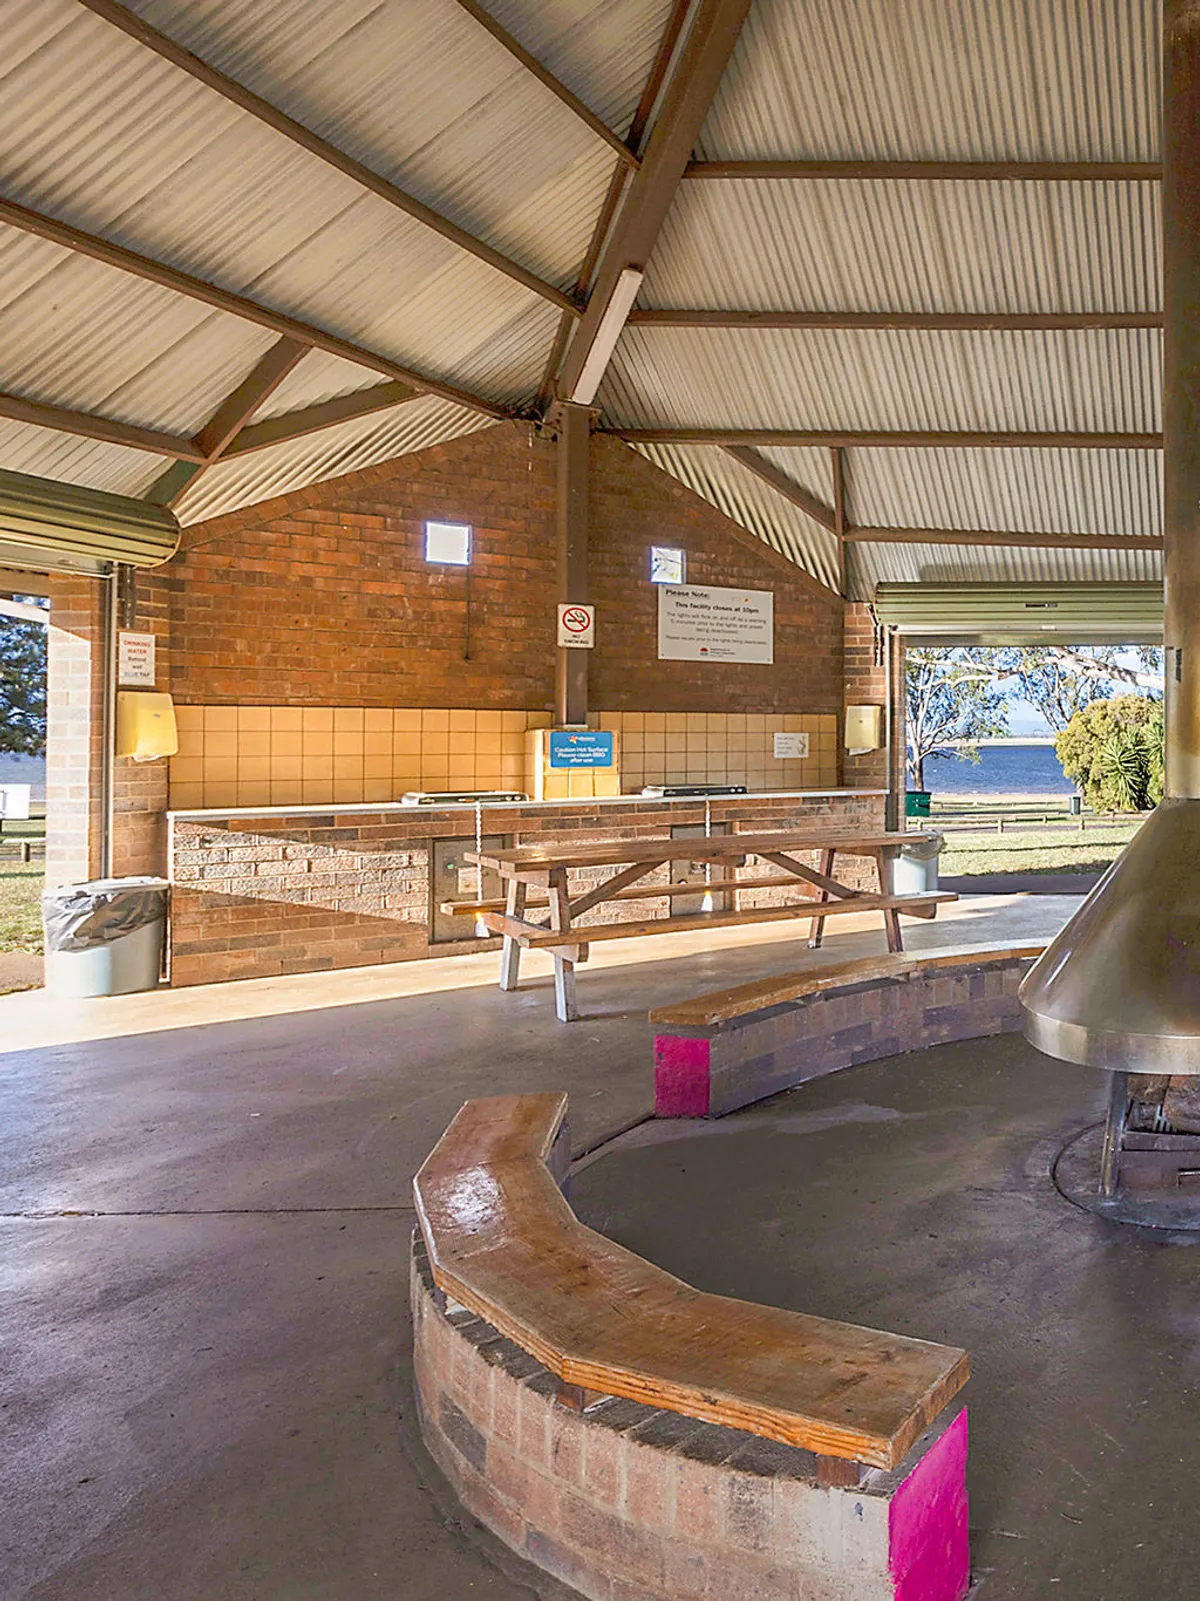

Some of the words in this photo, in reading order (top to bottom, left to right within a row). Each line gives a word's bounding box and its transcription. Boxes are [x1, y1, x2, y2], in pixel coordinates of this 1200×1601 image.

[665, 589, 690, 598] Please
[691, 591, 711, 599] Note:
[689, 602, 711, 611] facility
